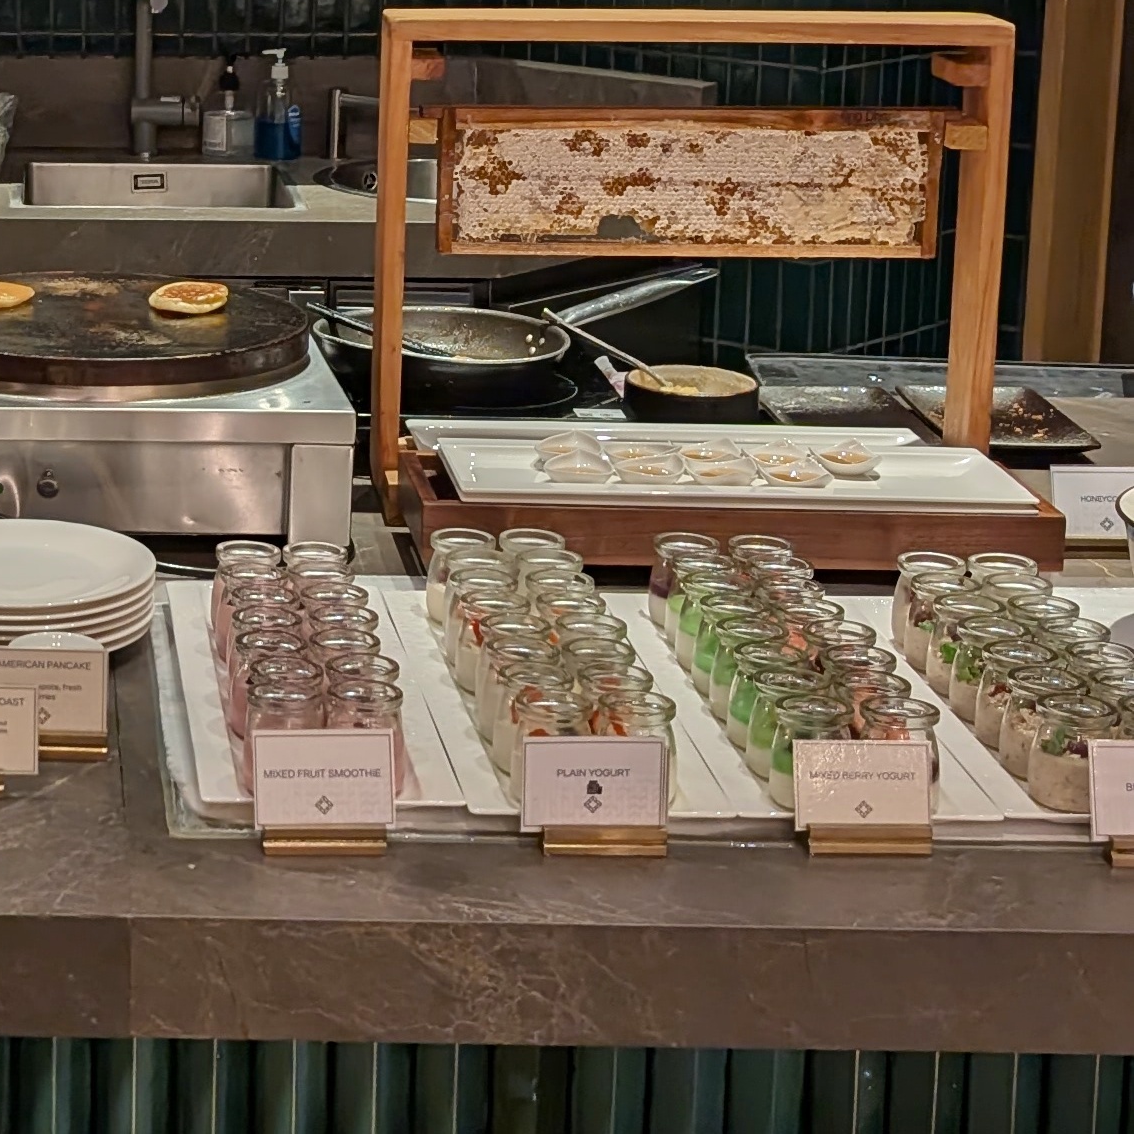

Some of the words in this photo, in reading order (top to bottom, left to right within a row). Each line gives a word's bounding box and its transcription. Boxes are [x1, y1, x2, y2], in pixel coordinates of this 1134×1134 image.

[47, 660, 91, 671] PANCAKE
[263, 769, 295, 779] MIXED
[297, 768, 326, 778] FRUIT
[328, 768, 382, 778] SMOOTHIE
[556, 768, 586, 777] PLAIN
[588, 768, 631, 777] YOGURT
[809, 770, 840, 780] MIXED
[842, 770, 873, 780] BERRY
[876, 771, 916, 781] YOGURT
